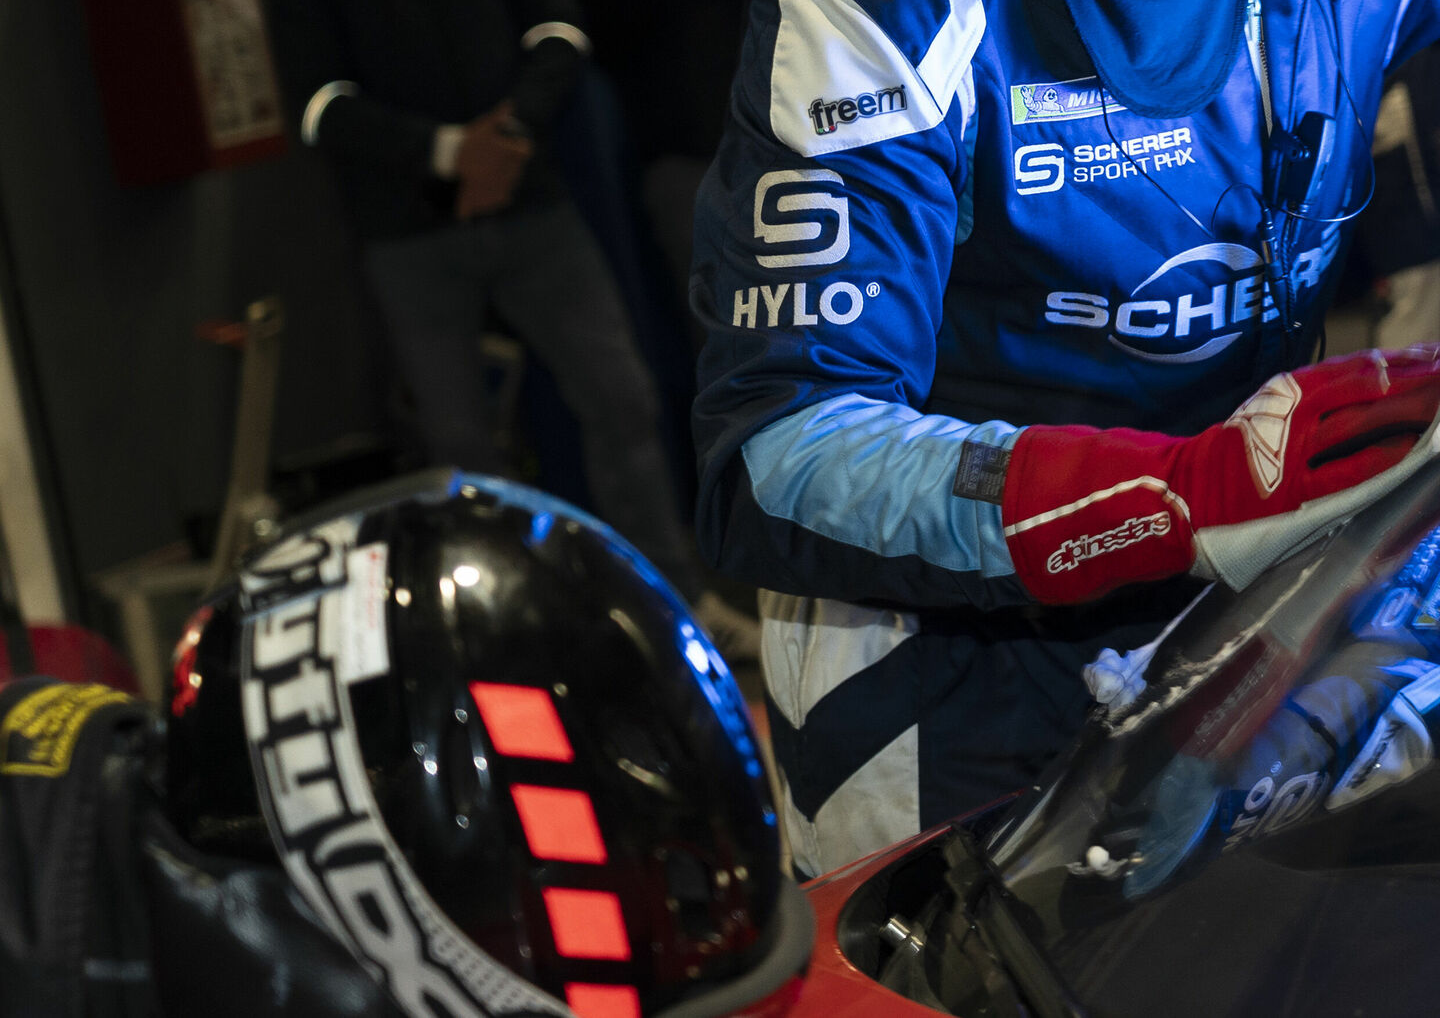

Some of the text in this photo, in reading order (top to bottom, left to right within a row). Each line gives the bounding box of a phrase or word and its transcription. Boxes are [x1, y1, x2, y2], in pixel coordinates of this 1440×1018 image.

[808, 86, 908, 135] freem
[1073, 127, 1192, 163] SCHERER
[1073, 147, 1196, 183] SPORT PHX
[1047, 510, 1172, 575] alpinestars
